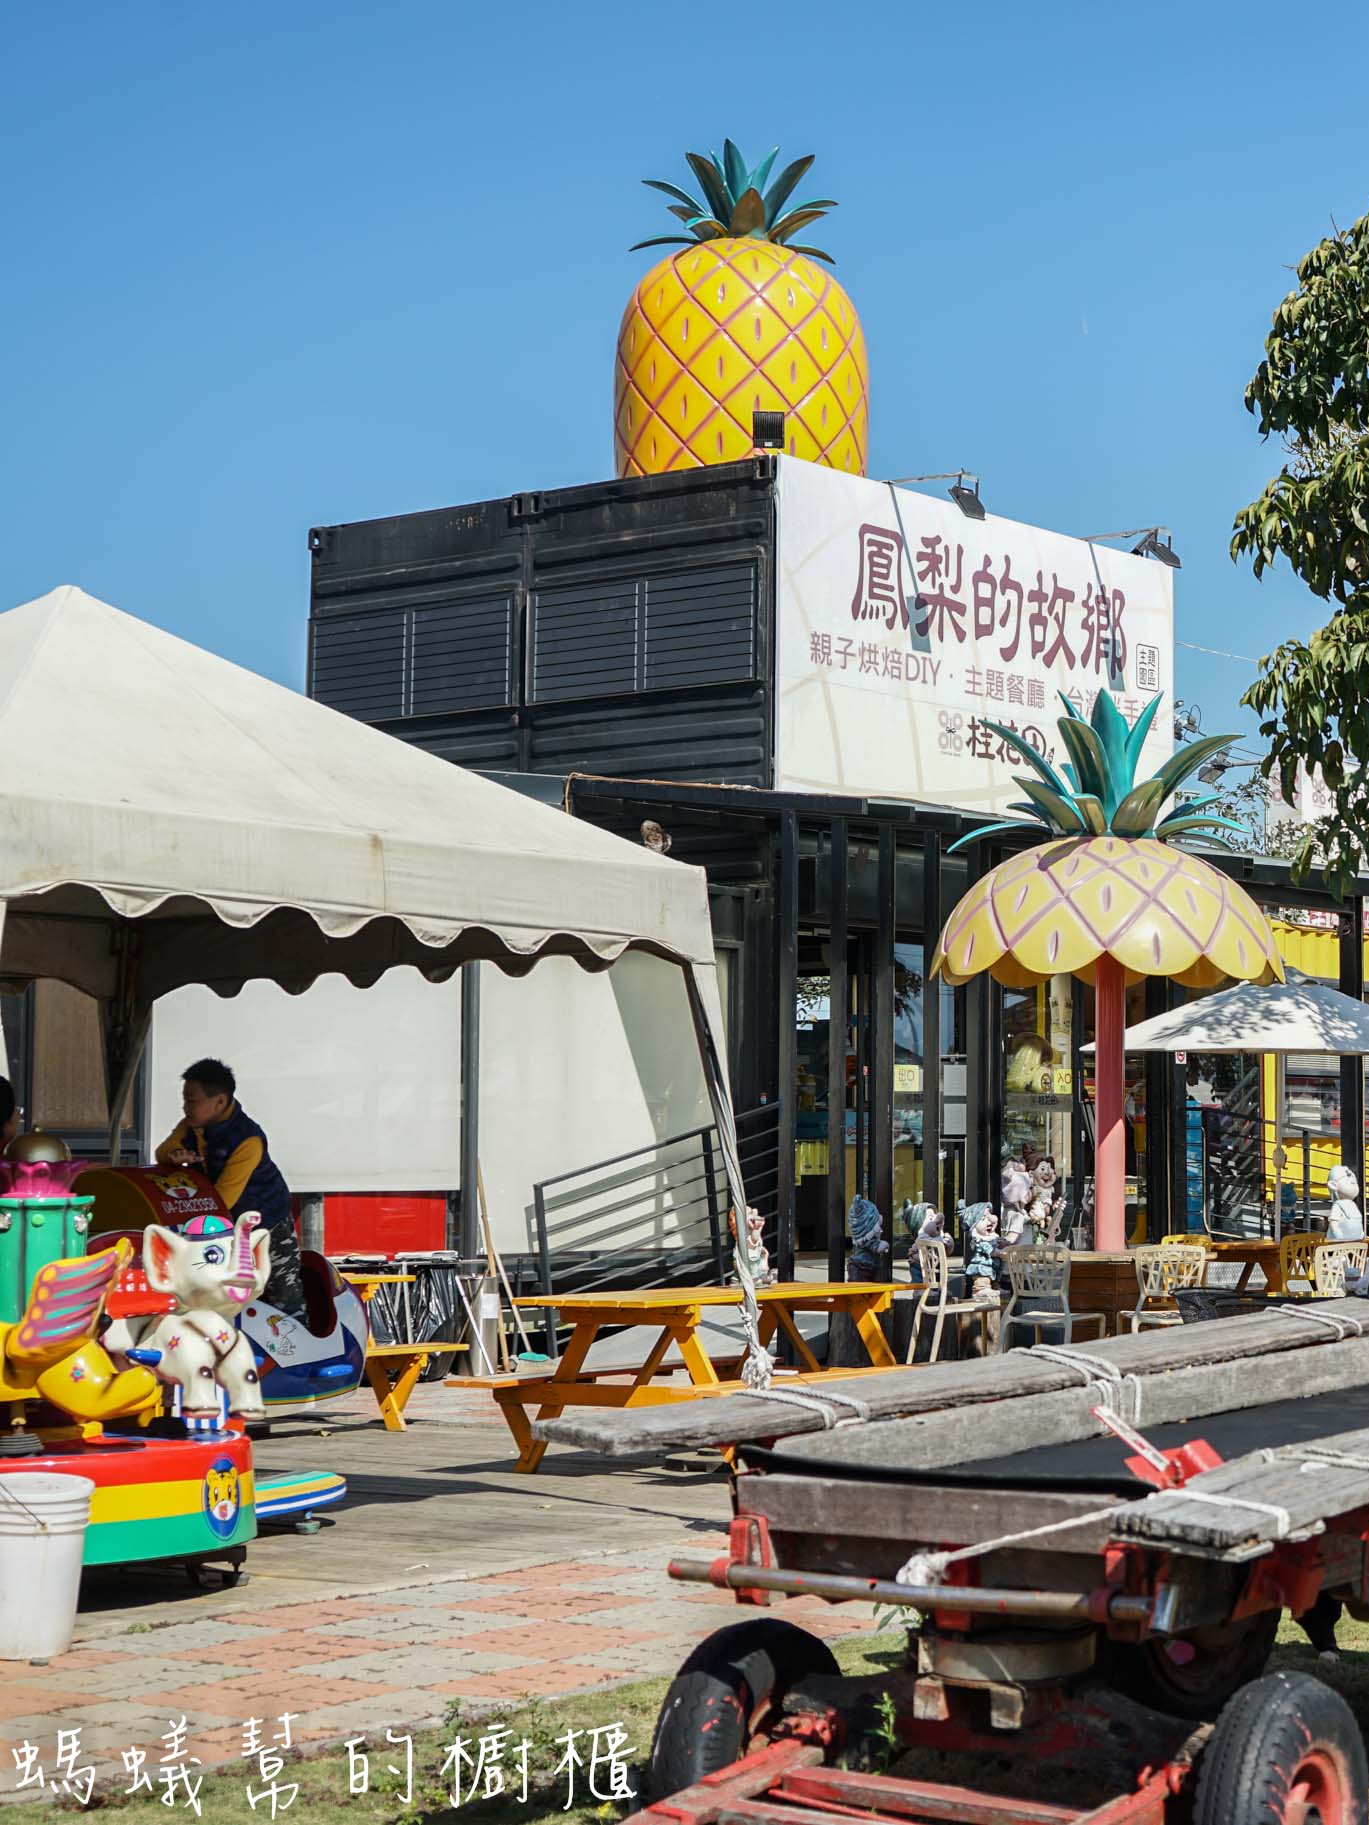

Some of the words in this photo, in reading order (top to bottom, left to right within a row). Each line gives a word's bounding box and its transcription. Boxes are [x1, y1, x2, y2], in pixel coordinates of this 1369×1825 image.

[851, 522, 1128, 681] 鳳梨的故鄉
[809, 630, 942, 687] 親子烘焙DIY
[964, 664, 1046, 709] 主題餐廳
